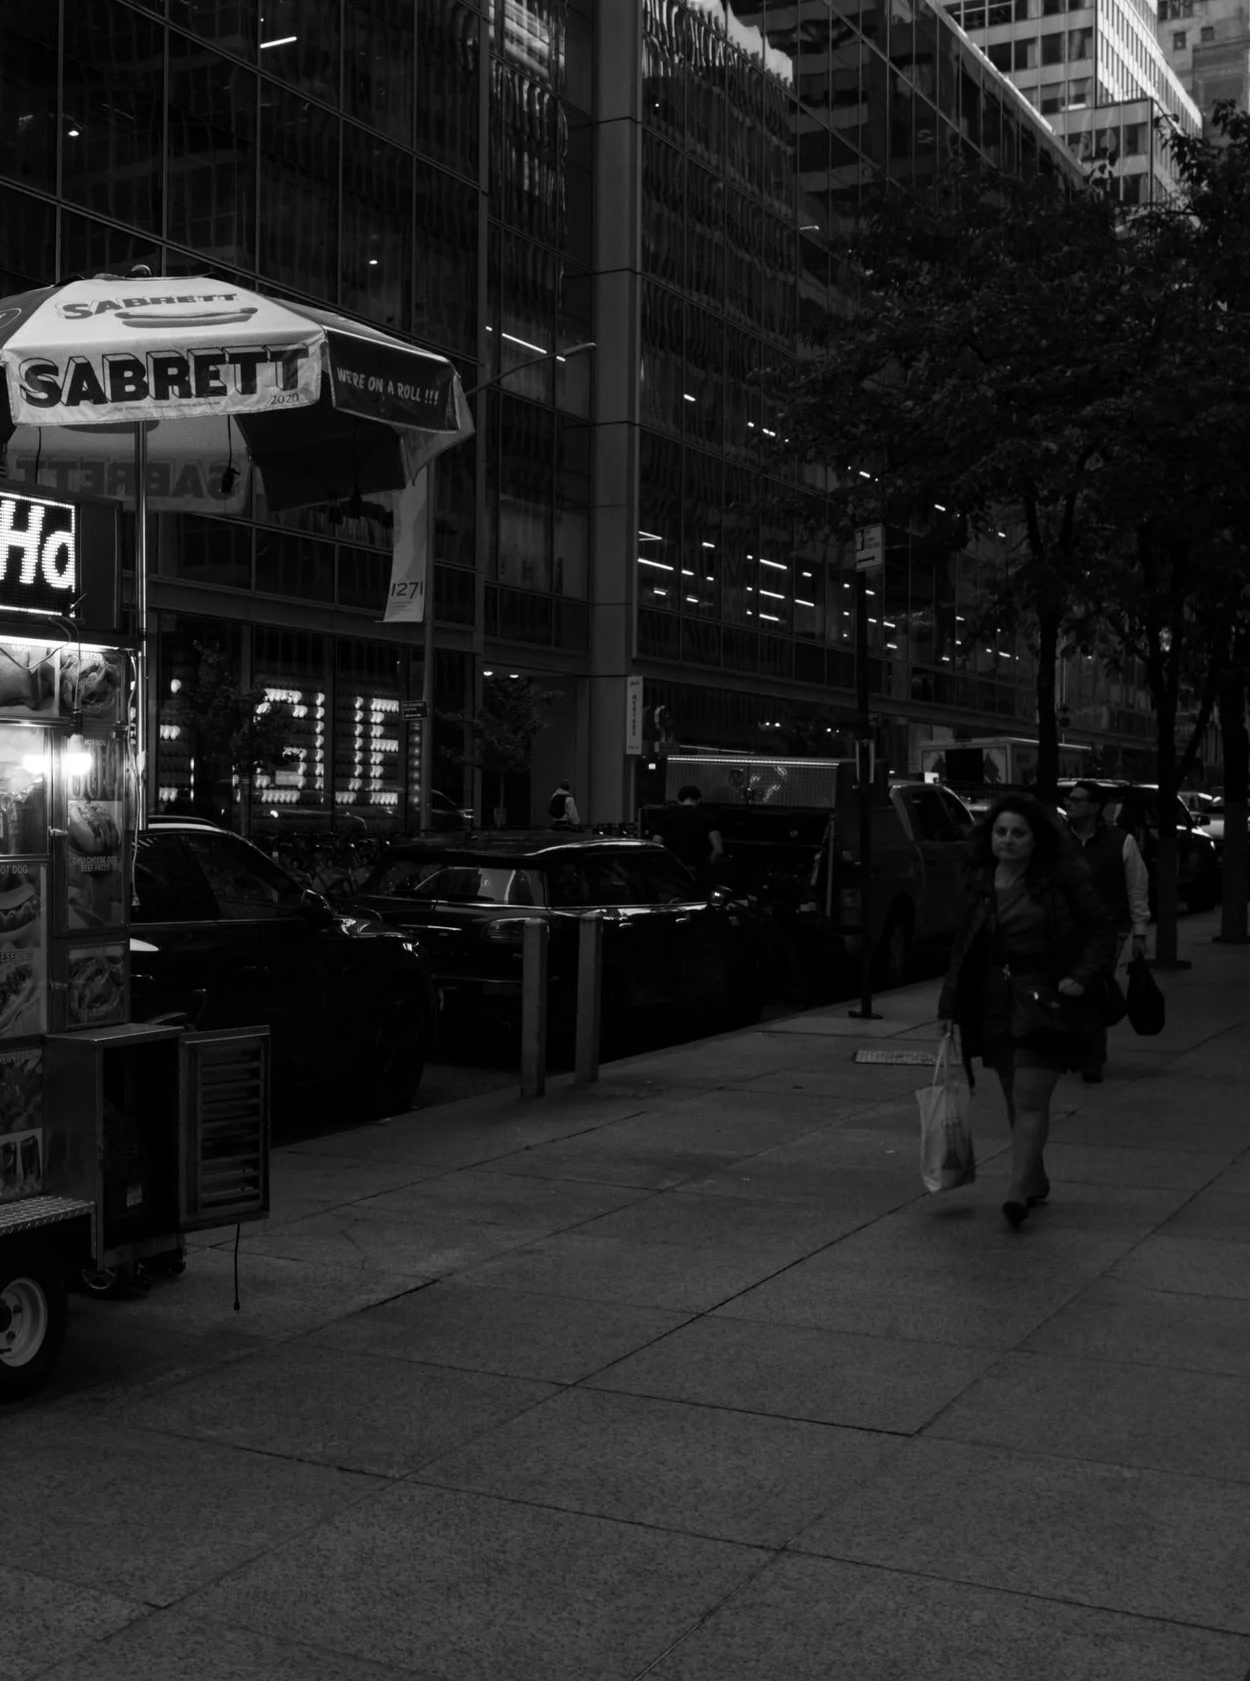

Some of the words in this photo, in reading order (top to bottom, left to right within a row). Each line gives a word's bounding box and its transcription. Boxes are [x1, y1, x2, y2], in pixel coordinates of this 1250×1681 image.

[56, 293, 239, 321] SABRETT
[18, 343, 310, 408] SABRETT
[368, 376, 384, 393] ON
[387, 379, 395, 396] A
[397, 382, 421, 402] ROLL
[391, 581, 423, 599] 1271
[12, 864, 29, 874] DOG
